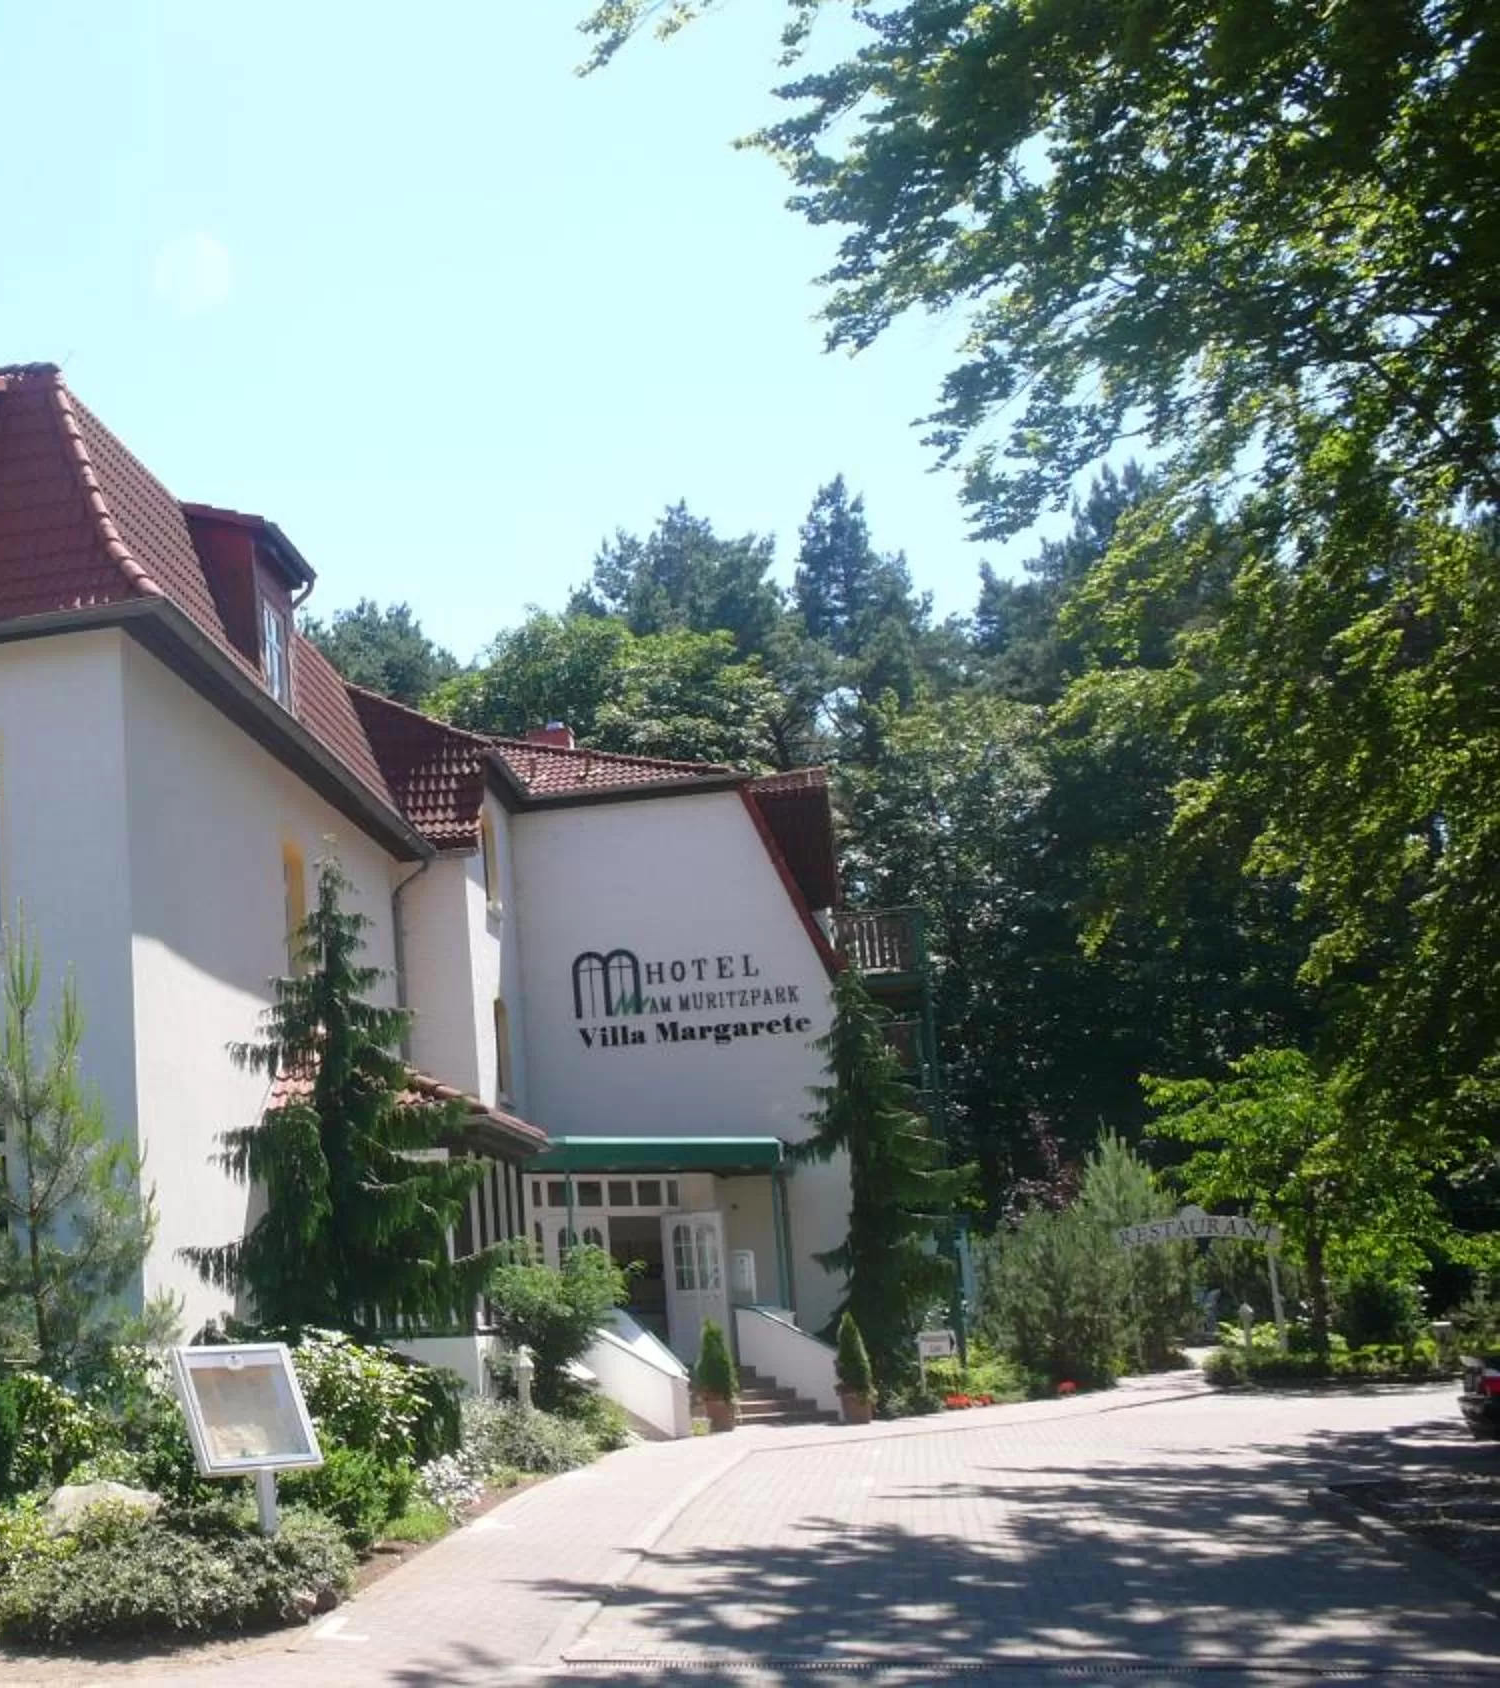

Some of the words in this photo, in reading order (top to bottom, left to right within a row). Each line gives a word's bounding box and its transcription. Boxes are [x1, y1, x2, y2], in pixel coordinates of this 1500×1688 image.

[645, 953, 760, 985] HOTEL
[649, 995, 673, 1015] AM
[579, 1025, 646, 1049] Villa
[655, 1013, 812, 1045] Margarete
